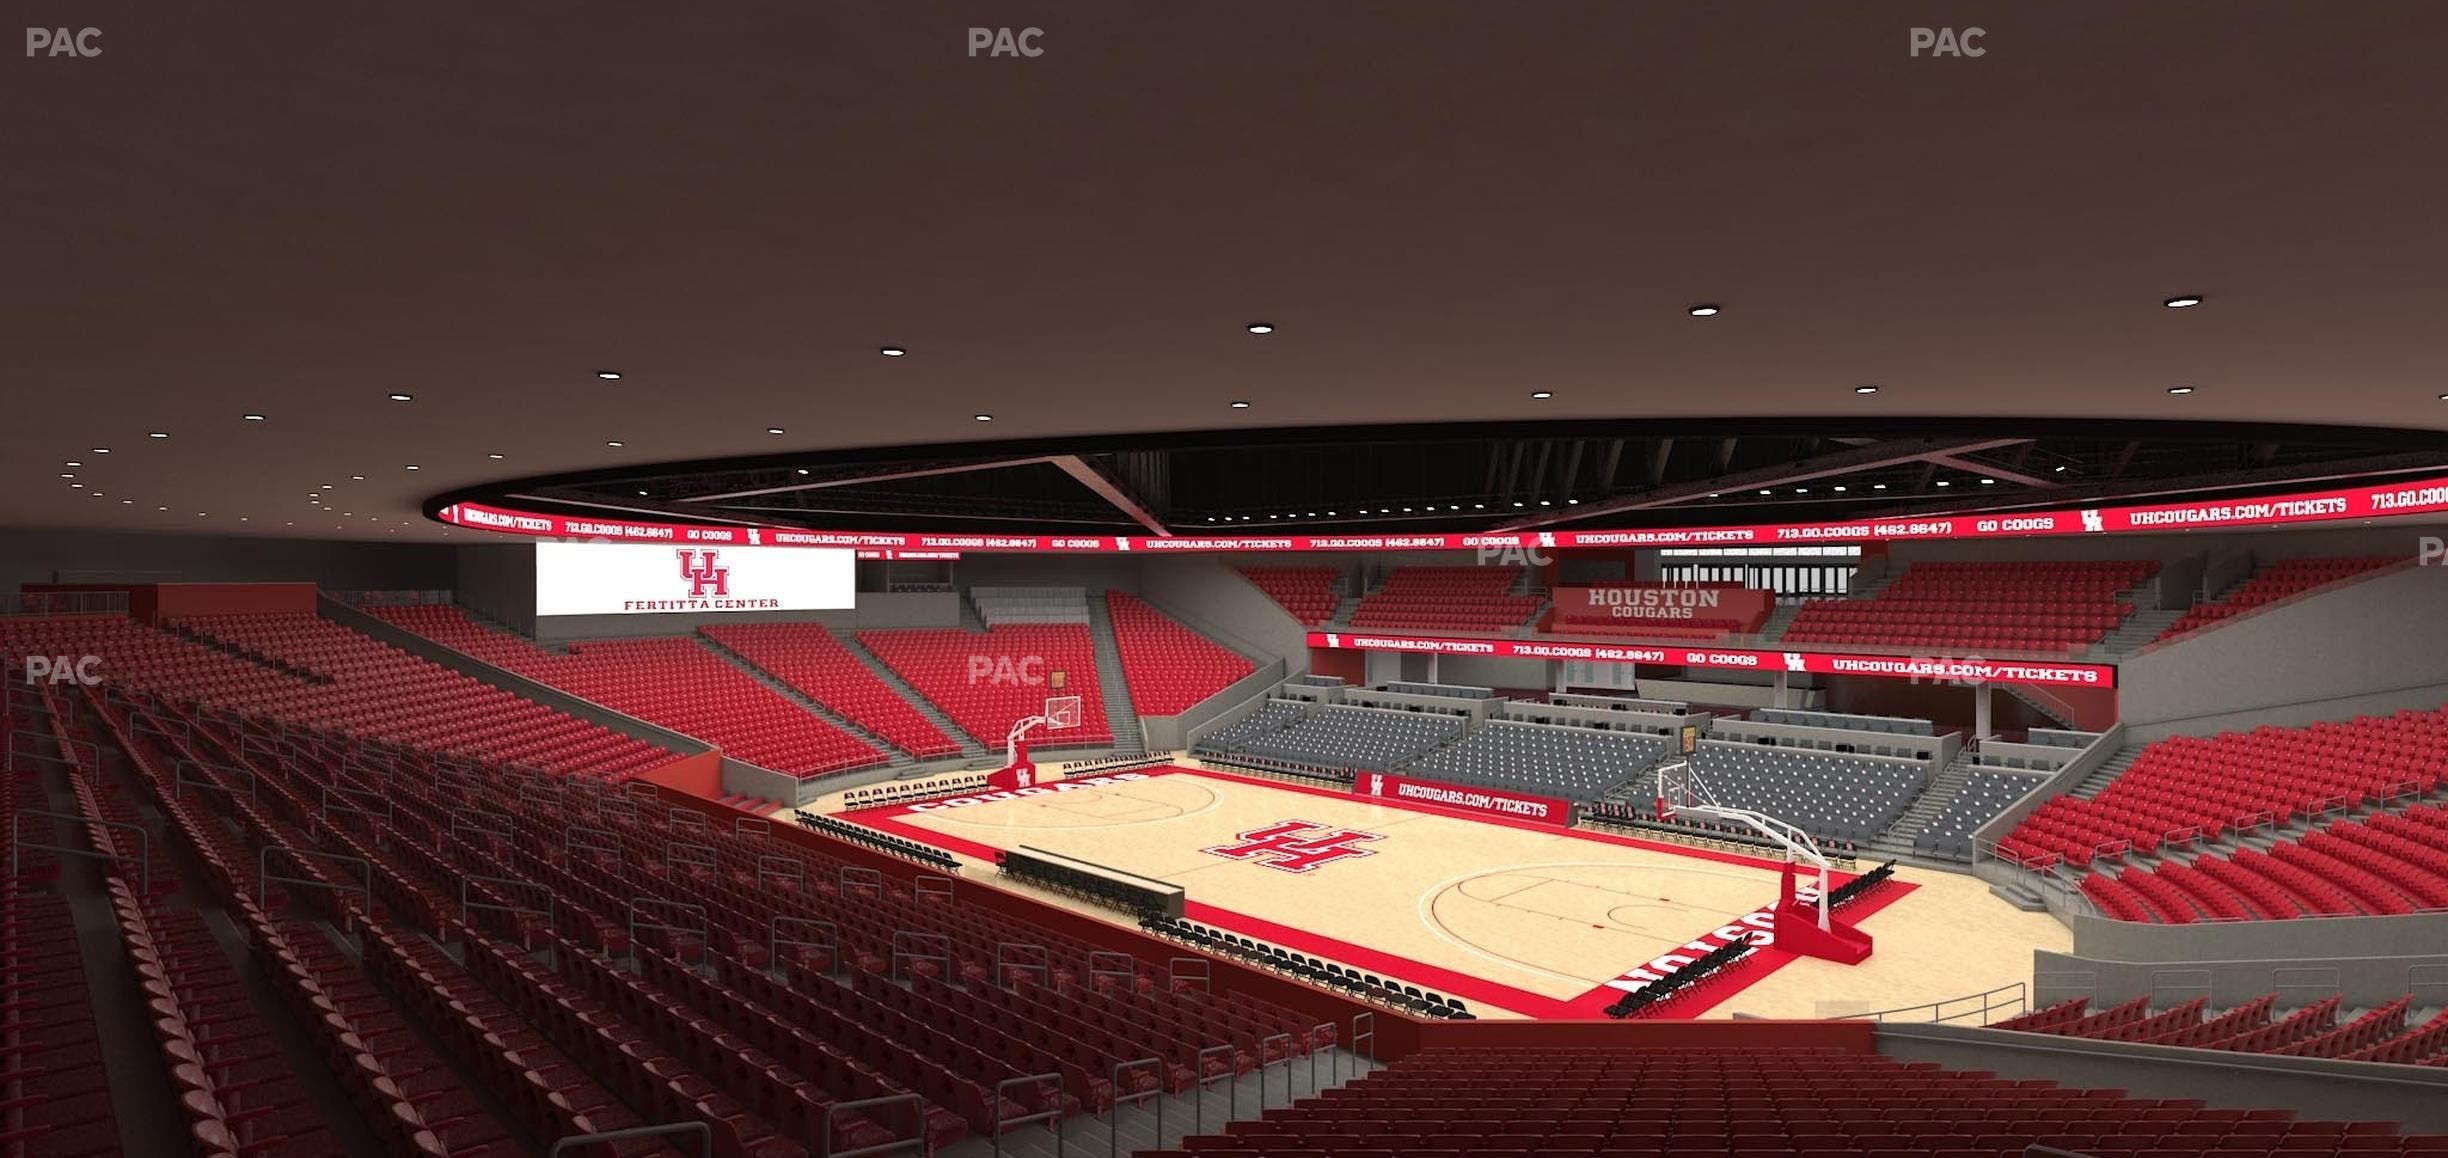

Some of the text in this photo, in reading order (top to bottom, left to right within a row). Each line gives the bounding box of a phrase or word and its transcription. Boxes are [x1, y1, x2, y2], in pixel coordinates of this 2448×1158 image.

[687, 530, 700, 539] GO
[1052, 540, 1066, 548] GO
[1146, 540, 1292, 548] UHCOUGARS.COM/TICKETS
[1463, 537, 1478, 546] GO
[1481, 536, 1519, 546] COOGS
[1575, 530, 1754, 544] UHCOUGARS.COM/TICKETS
[1977, 521, 1997, 532] GO
[2002, 518, 2054, 531] COOGS
[2129, 497, 2346, 525] UHCOUGARS.COM/TICKETS
[2371, 486, 2448, 509] 713.GO.COO
[624, 599, 779, 610] FERTITTA CENTER
[1588, 589, 1720, 607] HOUSTON
[1612, 606, 1693, 618] COUGARS
[1353, 639, 1494, 653] UHCOUGARS.COM/TICKETS
[1686, 653, 1706, 663] GO
[1709, 654, 1758, 666] COOGS
[1832, 658, 2097, 682] UHCOUGARS.COM/TICKETS
[1398, 782, 1548, 817] UHCOUGARS.COM/TICKETS
